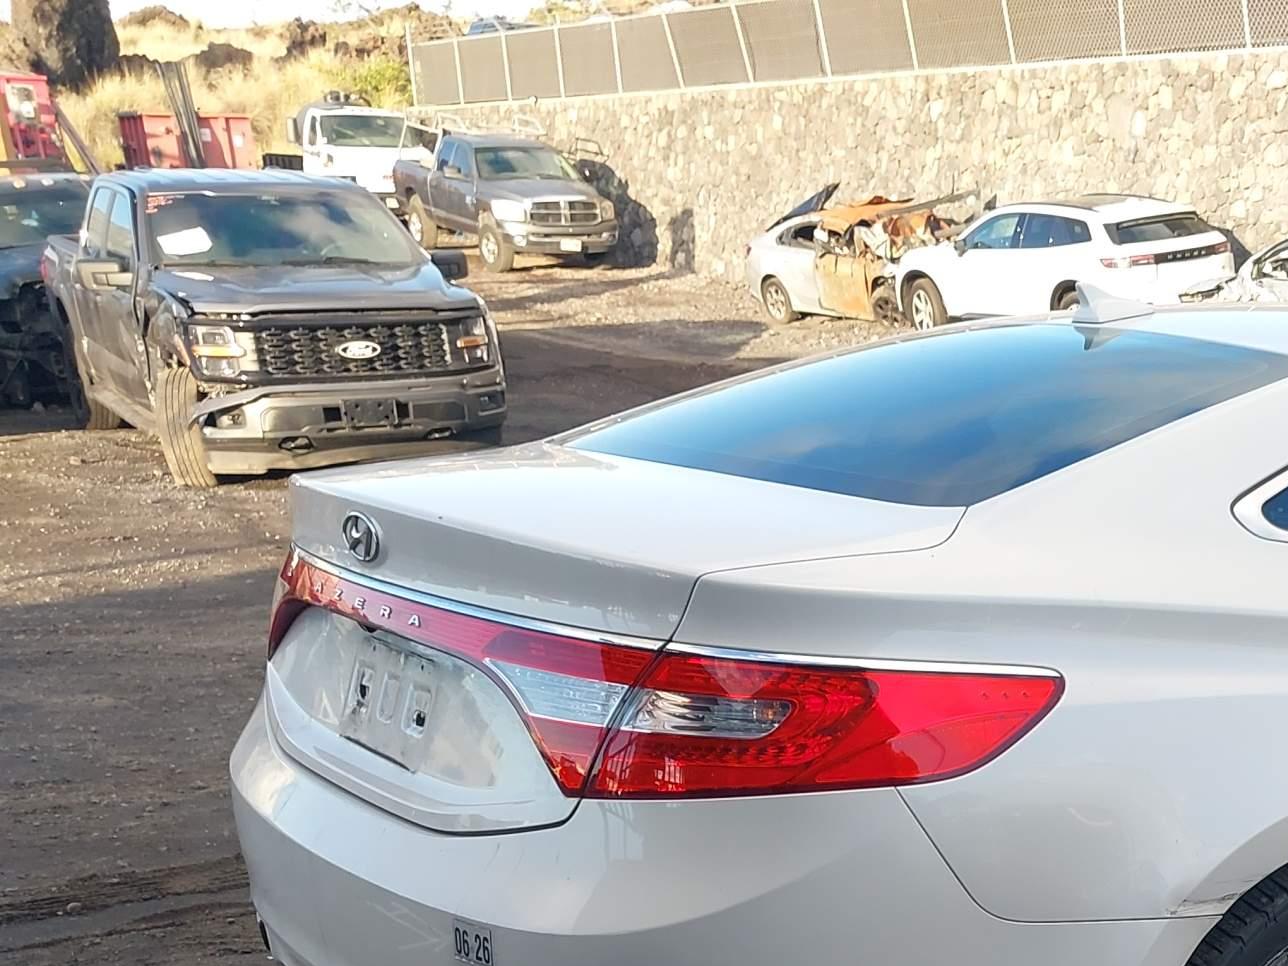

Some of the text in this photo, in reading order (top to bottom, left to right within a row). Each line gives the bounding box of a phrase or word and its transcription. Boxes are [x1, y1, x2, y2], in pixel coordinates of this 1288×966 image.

[312, 580, 421, 628] AZERA
[454, 926, 491, 965] 06 26
